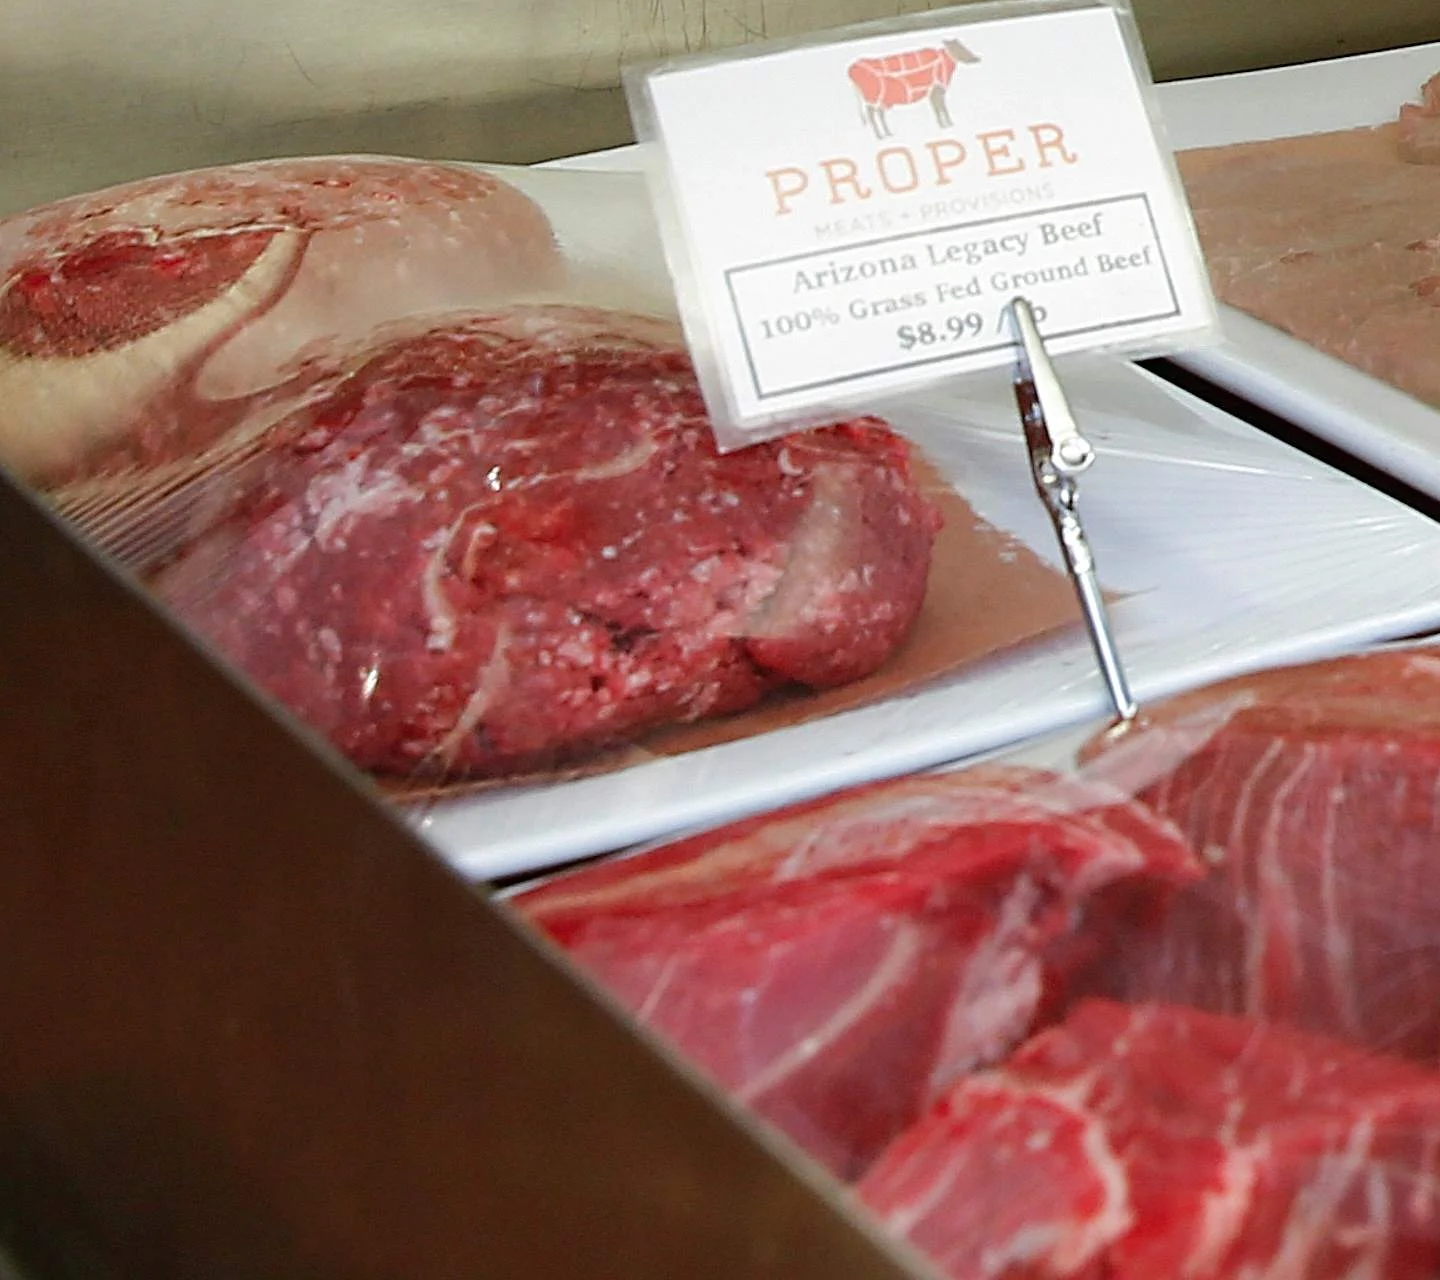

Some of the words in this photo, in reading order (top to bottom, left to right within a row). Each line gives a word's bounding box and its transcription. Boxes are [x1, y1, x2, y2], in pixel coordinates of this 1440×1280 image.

[764, 122, 1078, 216] PROPER
[813, 212, 891, 241] MEATS
[919, 182, 1056, 223] PROVISIONS
[758, 303, 841, 342] 100%
[848, 289, 927, 324] Grass
[936, 273, 982, 306] Fed
[990, 254, 1089, 294] Ground
[1098, 245, 1153, 277] Beef
[791, 248, 918, 295] Arizona
[925, 229, 1030, 270] Legacy
[1040, 213, 1104, 247] Beef
[896, 312, 983, 351] $8.99
